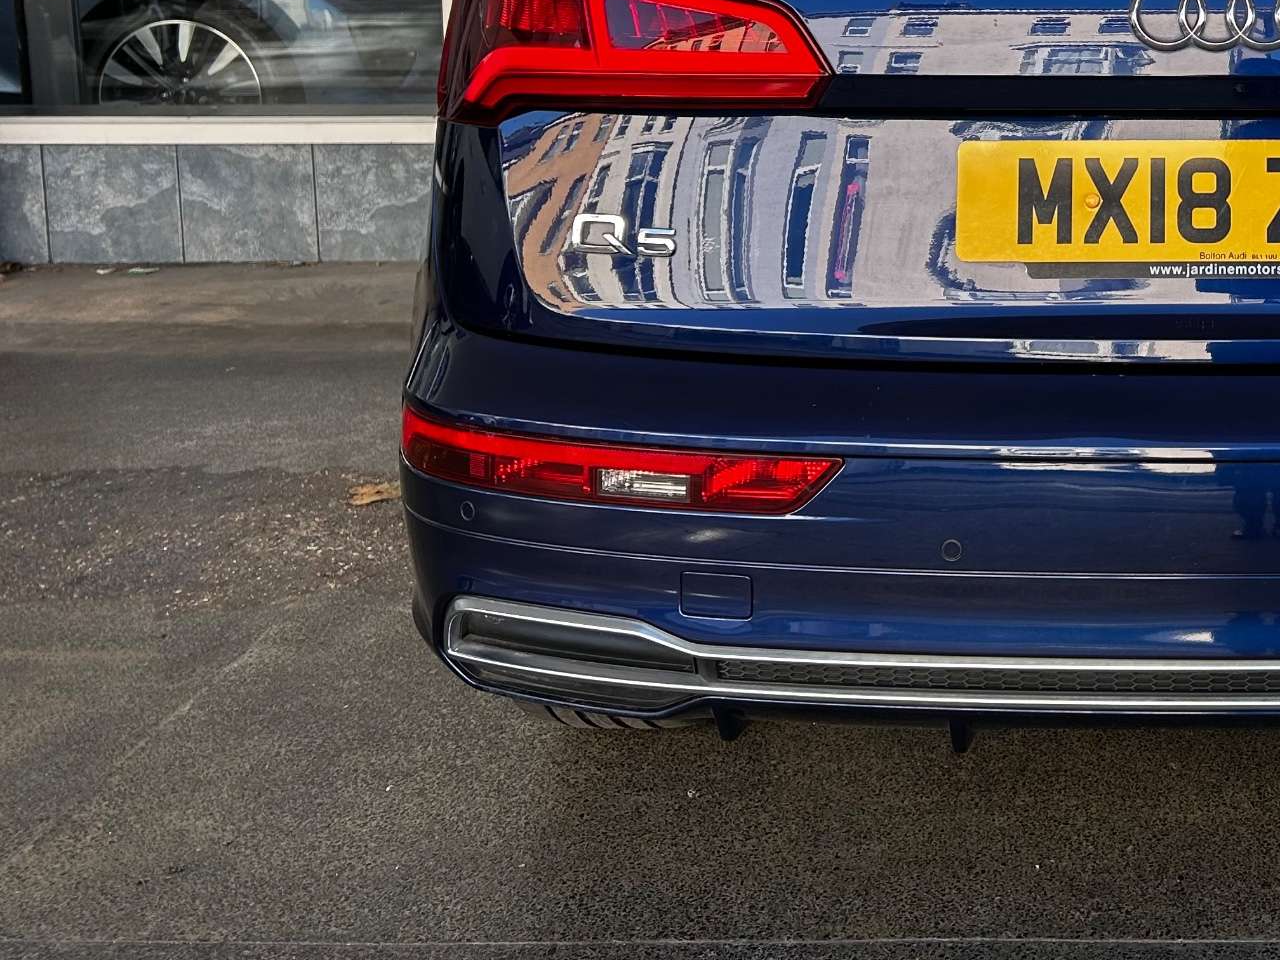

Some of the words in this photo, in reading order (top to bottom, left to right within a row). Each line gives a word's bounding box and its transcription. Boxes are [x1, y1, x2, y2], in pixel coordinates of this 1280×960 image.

[1017, 157, 1231, 245] MX18
[572, 214, 676, 257] Q5
[1228, 251, 1247, 260] Audi
